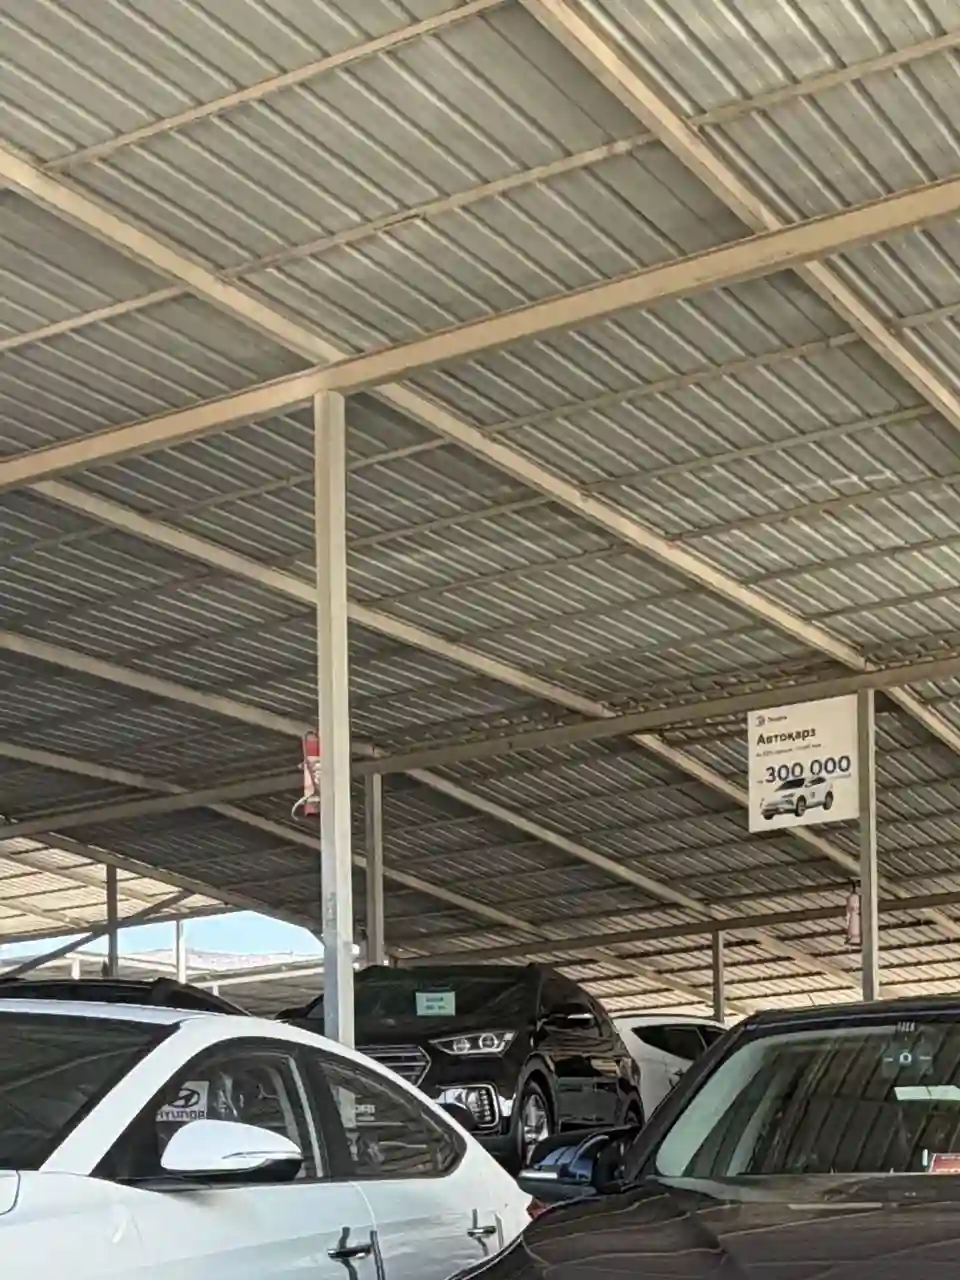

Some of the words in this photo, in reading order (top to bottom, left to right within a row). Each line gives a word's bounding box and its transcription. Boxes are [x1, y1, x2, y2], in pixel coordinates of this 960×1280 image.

[756, 728, 816, 746] Автоқарз
[765, 762, 804, 783] 300
[810, 755, 851, 776] 000
